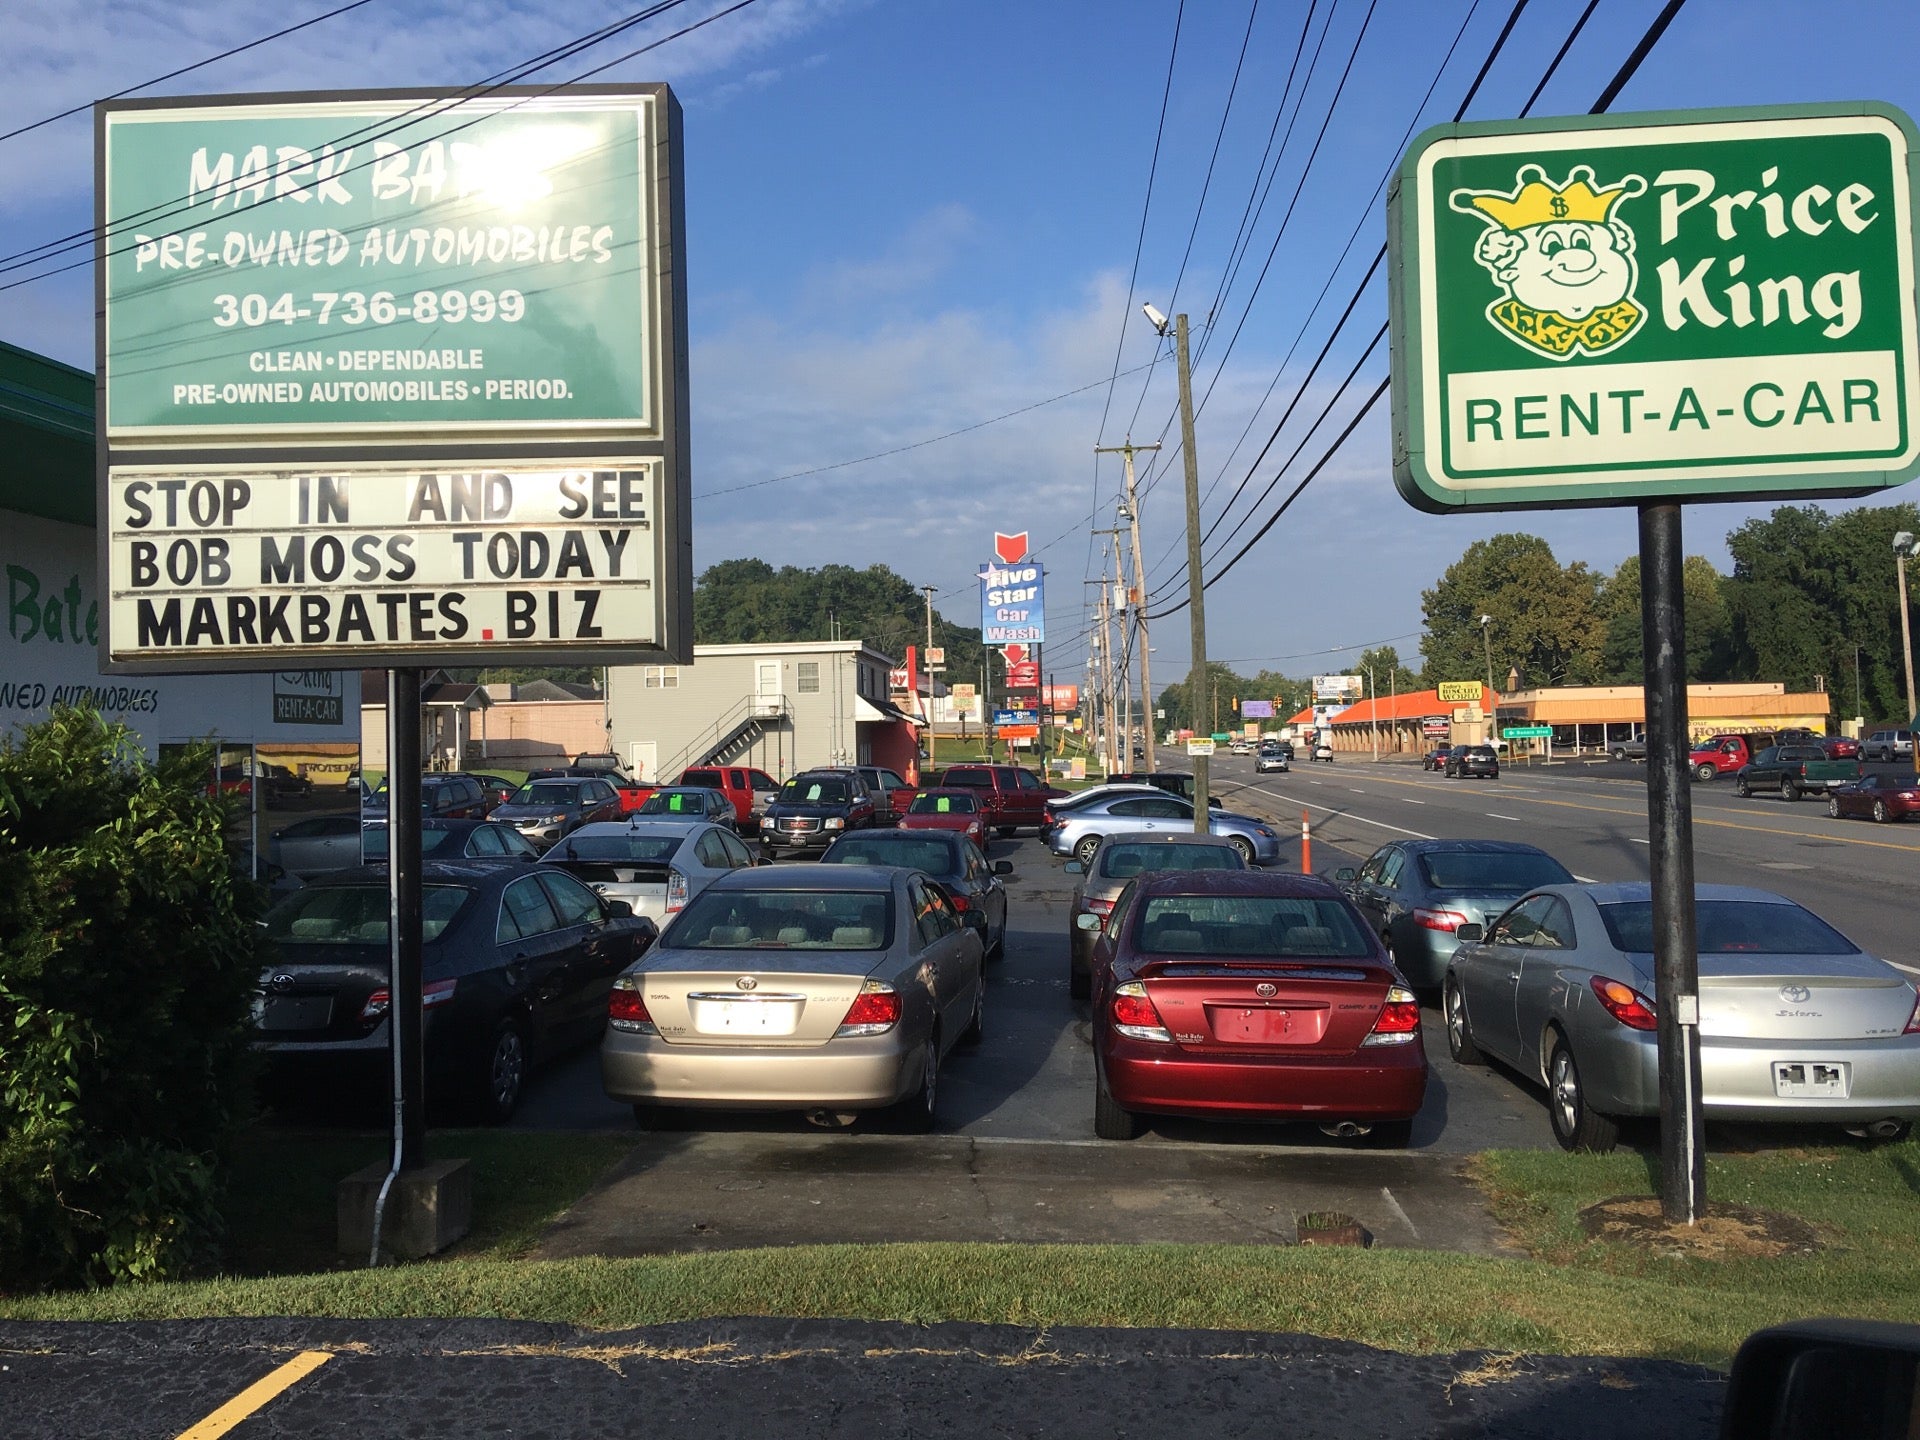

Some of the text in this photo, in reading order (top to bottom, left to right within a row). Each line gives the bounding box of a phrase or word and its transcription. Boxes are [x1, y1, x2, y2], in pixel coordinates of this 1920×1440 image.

[188, 143, 353, 210] MARK
[1653, 166, 1879, 245] Price
[135, 225, 613, 273] PRE-OWNED AUTOMOBILES
[212, 289, 526, 327] 304-736-8999
[1656, 254, 1862, 338] King
[173, 382, 303, 405] PRE-OWNED
[1466, 379, 1881, 442] RENT-A-CAR
[124, 471, 646, 528] STOP IN AND SEE
[131, 529, 630, 587] BOB MOSS TODAY
[989, 568, 1037, 588] Five
[988, 586, 1038, 607] Star
[996, 608, 1029, 622] Car
[986, 626, 1041, 640] Wash
